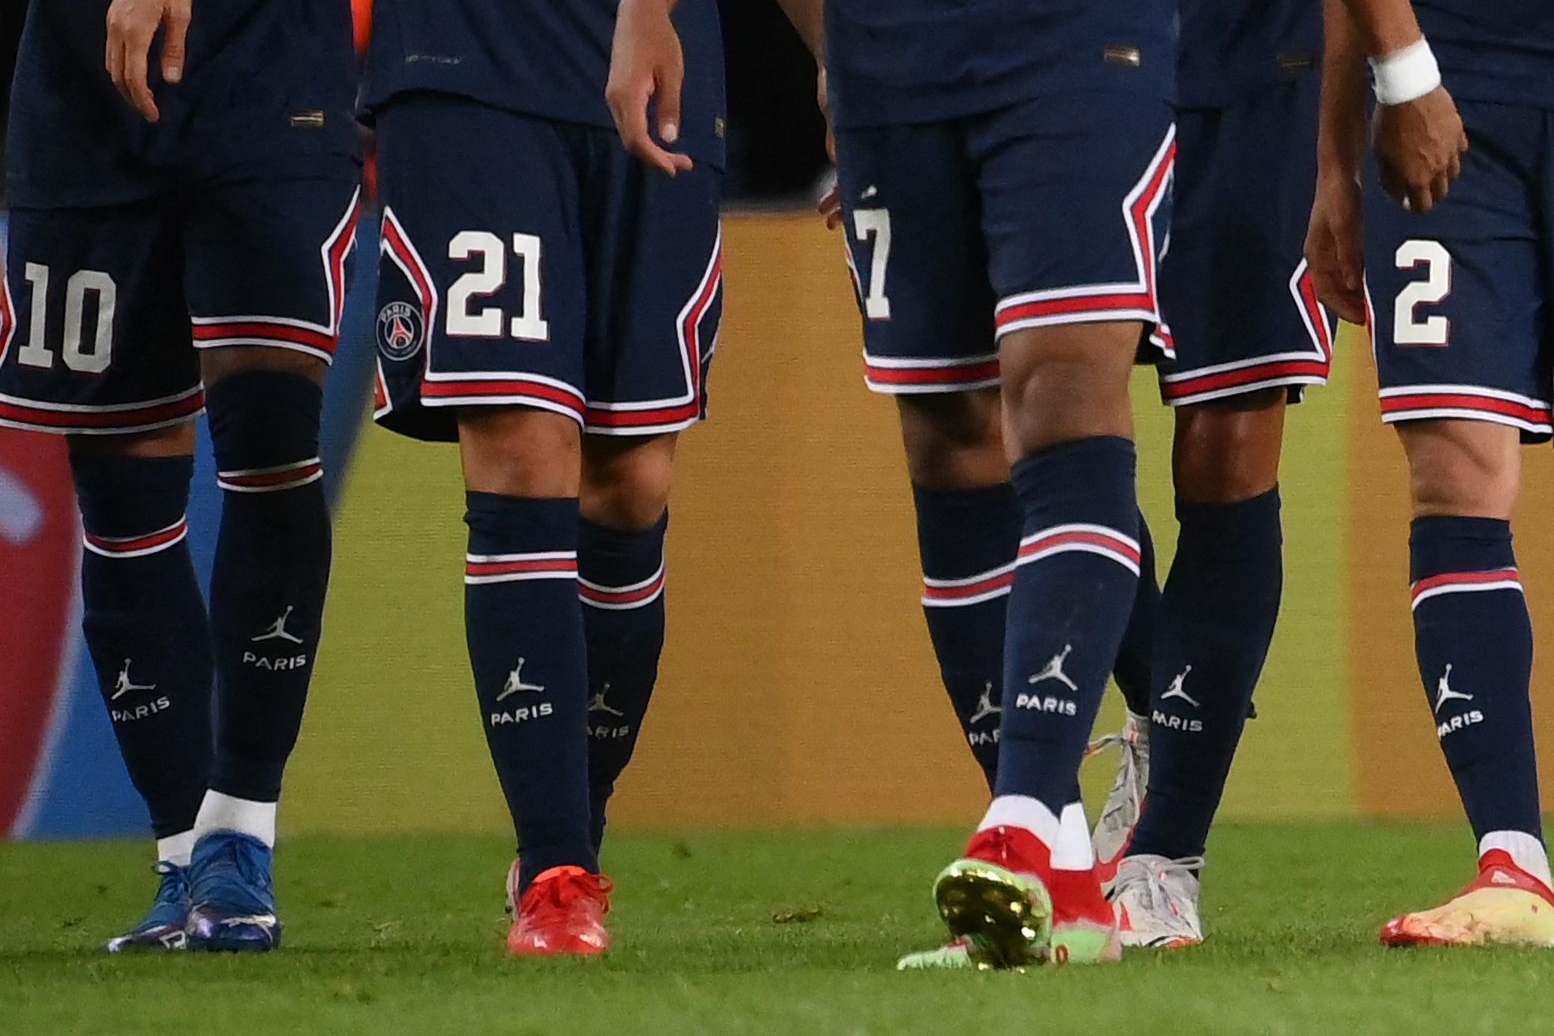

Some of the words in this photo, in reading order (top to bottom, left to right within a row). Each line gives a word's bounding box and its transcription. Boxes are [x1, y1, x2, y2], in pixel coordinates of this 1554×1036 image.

[853, 209, 891, 319] 7
[445, 231, 548, 340] 21
[1394, 240, 1452, 344] 2
[18, 263, 117, 373] 10
[380, 304, 411, 323] PARIS
[242, 651, 307, 671] PARIS
[111, 696, 170, 722] PARIS
[490, 703, 553, 726] PARIS
[1016, 693, 1077, 716] PARIS
